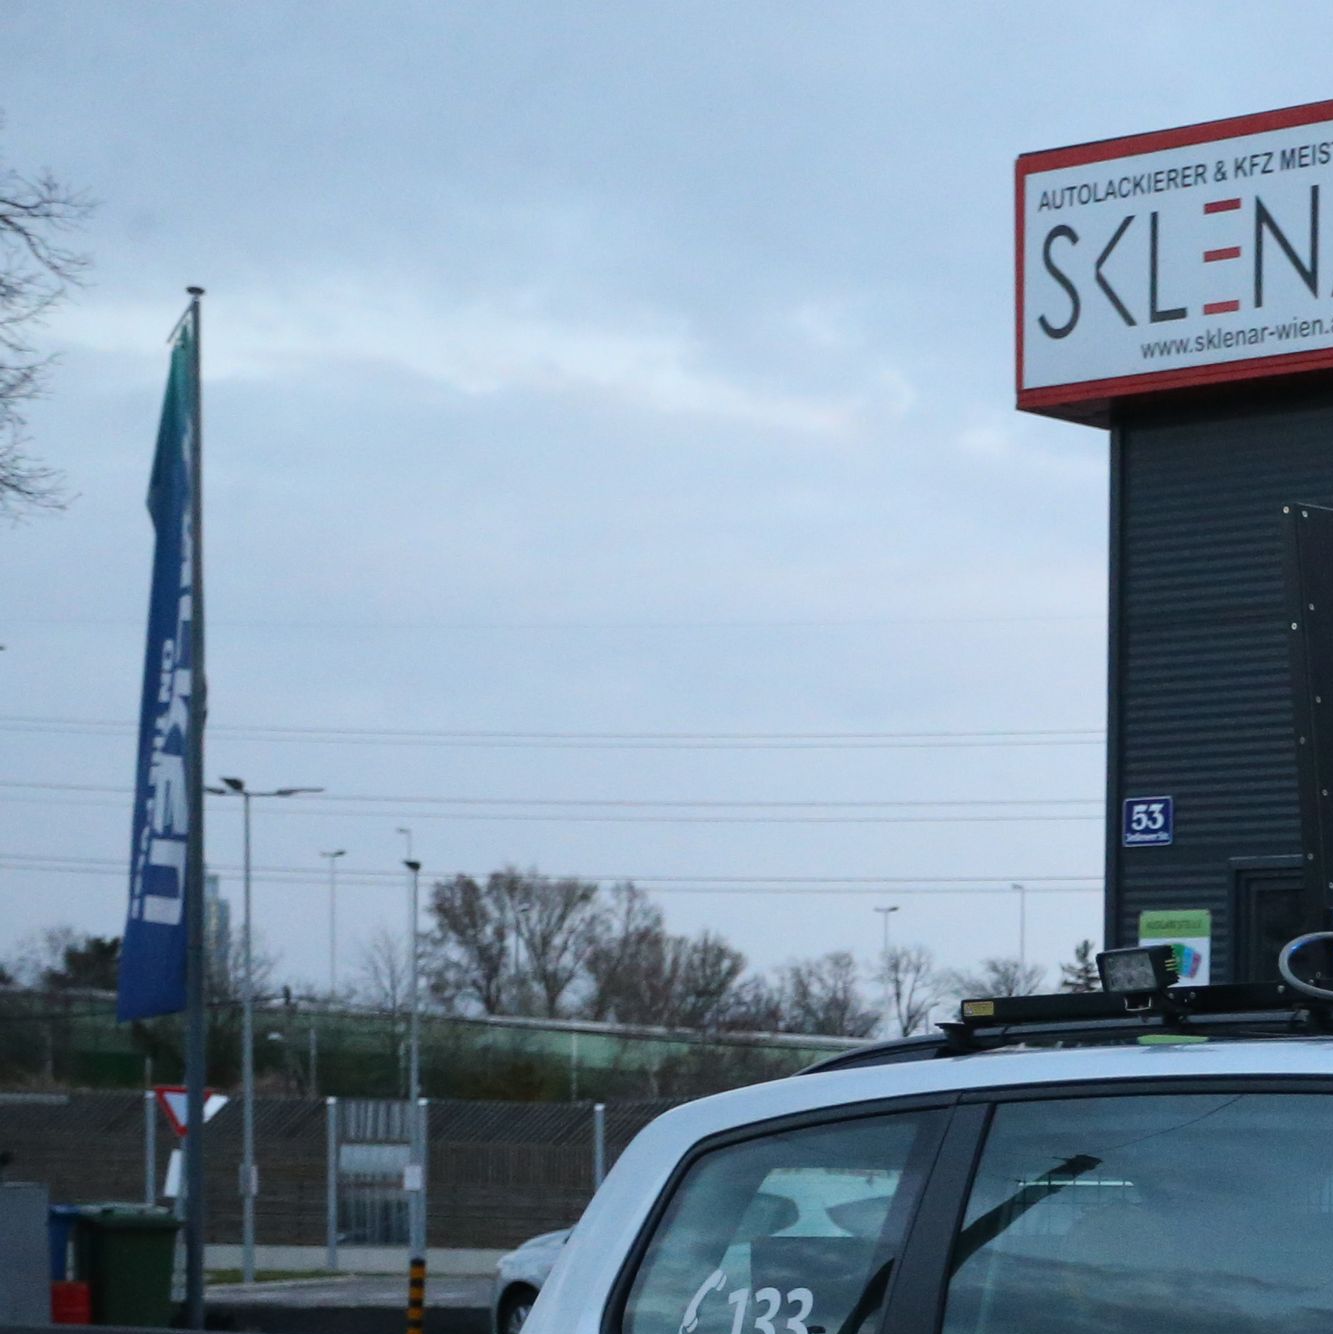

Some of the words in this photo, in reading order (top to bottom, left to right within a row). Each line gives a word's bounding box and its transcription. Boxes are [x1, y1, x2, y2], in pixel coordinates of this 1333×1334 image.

[1038, 163, 1208, 212] AUTOLACKIERER
[1213, 160, 1228, 183] &
[1234, 150, 1274, 178] KFZ
[1131, 803, 1165, 831] 53
